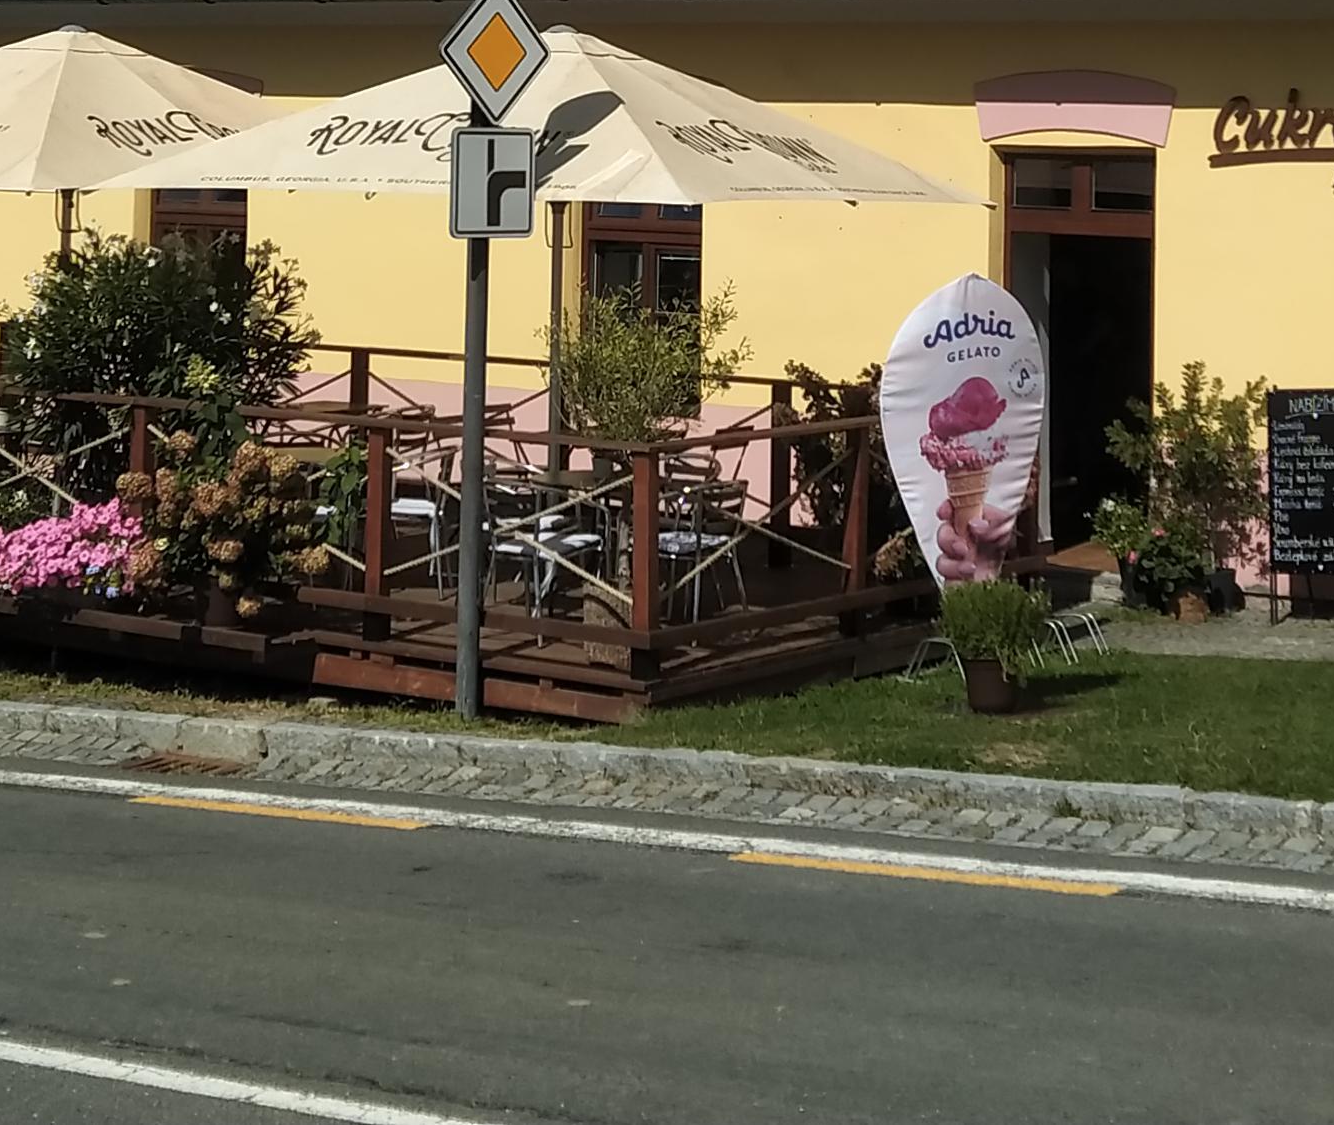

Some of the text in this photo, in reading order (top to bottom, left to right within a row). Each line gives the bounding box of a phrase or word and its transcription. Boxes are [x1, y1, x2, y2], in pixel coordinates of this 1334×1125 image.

[87, 111, 194, 156] ROYAL
[307, 115, 414, 156] ROYAL
[923, 310, 1016, 348] Adria
[947, 346, 1001, 363] GELATO
